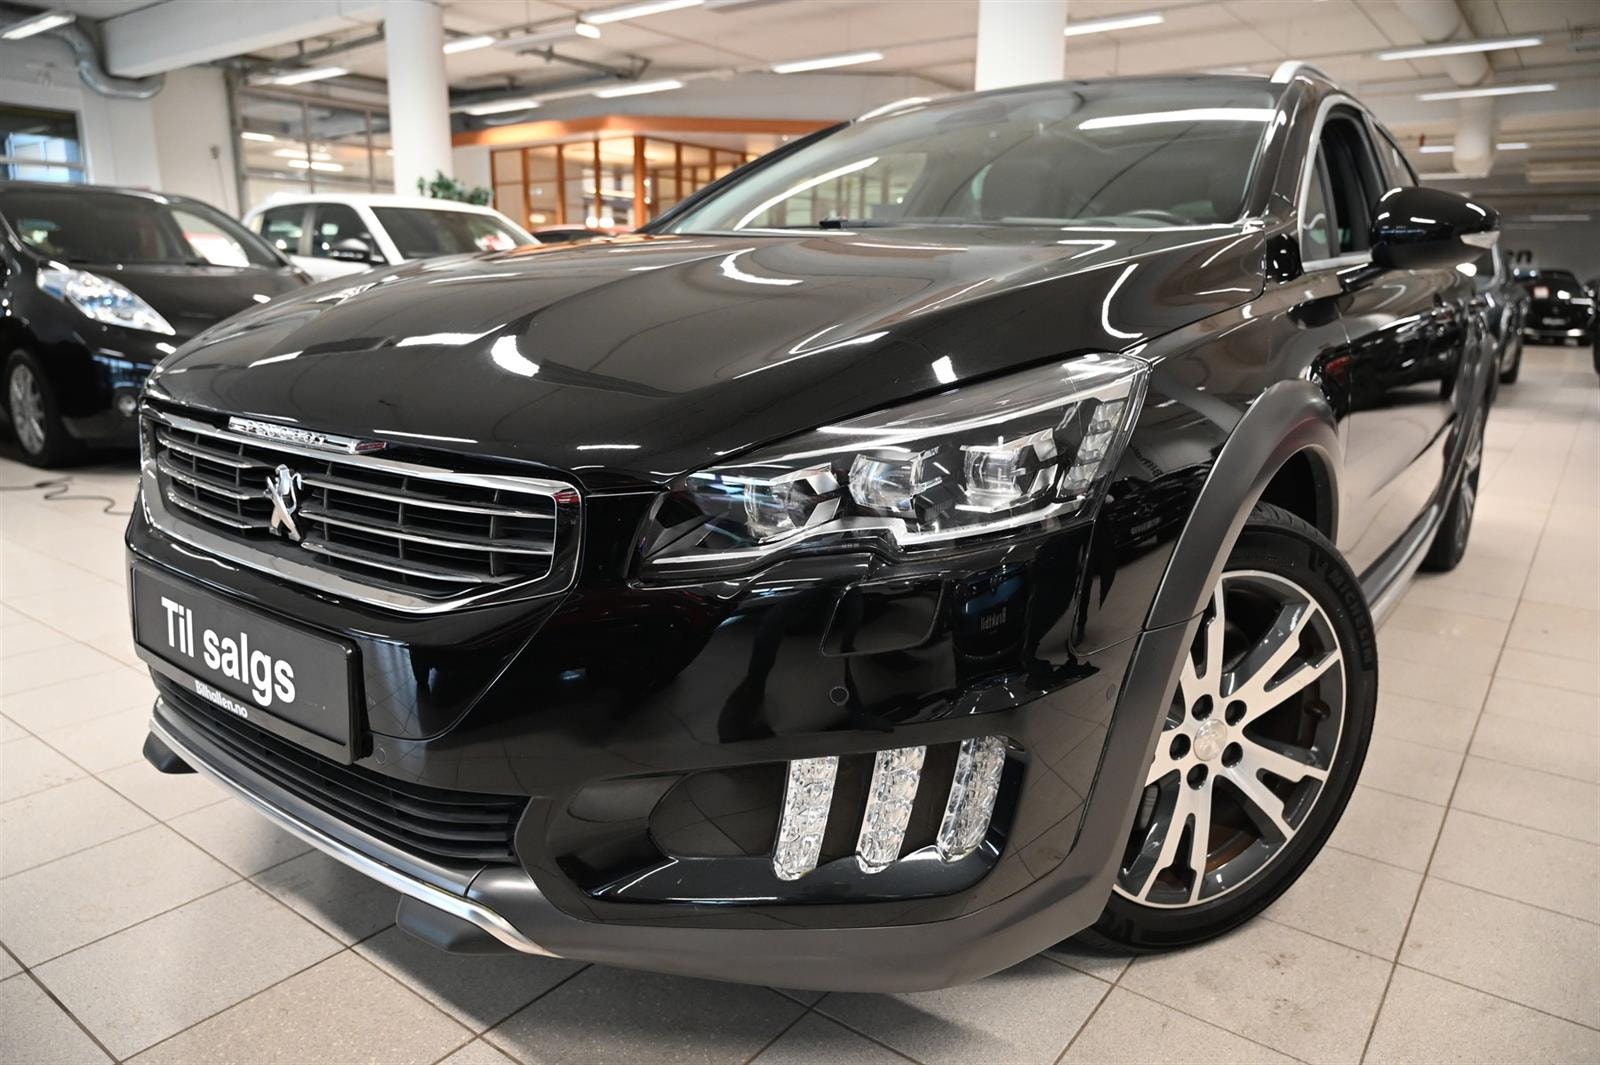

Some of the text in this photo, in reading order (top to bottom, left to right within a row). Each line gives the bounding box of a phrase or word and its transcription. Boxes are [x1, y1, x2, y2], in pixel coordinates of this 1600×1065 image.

[161, 596, 296, 707] Til salgs
[1327, 567, 1375, 671] MICHELIN
[194, 679, 249, 719] Bilhallen.no
